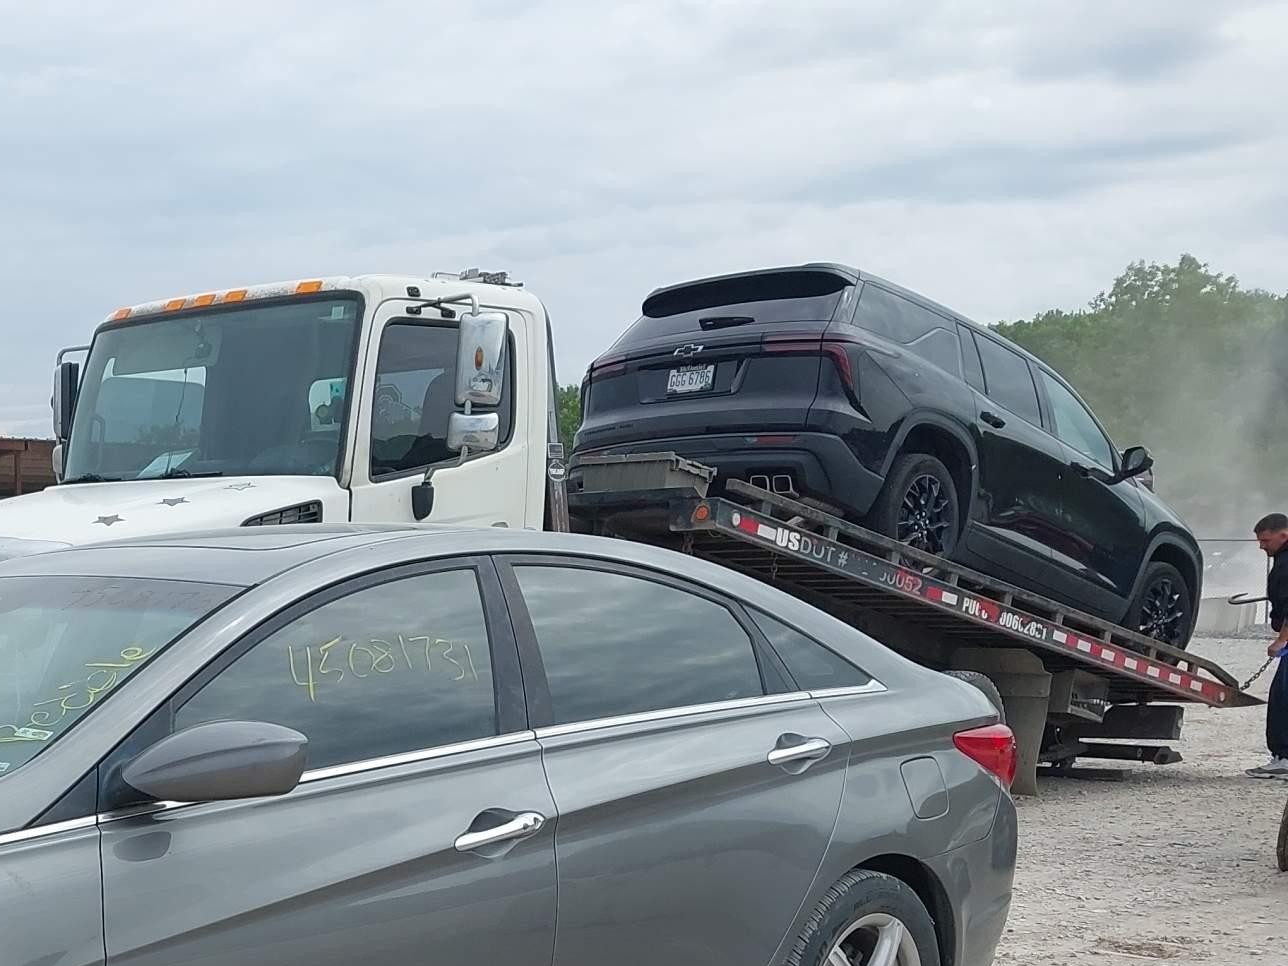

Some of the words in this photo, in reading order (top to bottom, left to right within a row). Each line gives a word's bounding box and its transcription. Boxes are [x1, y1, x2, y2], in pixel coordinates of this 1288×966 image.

[670, 373, 688, 389] GGG
[688, 370, 716, 386] 6786
[287, 635, 478, 702] 45081731
